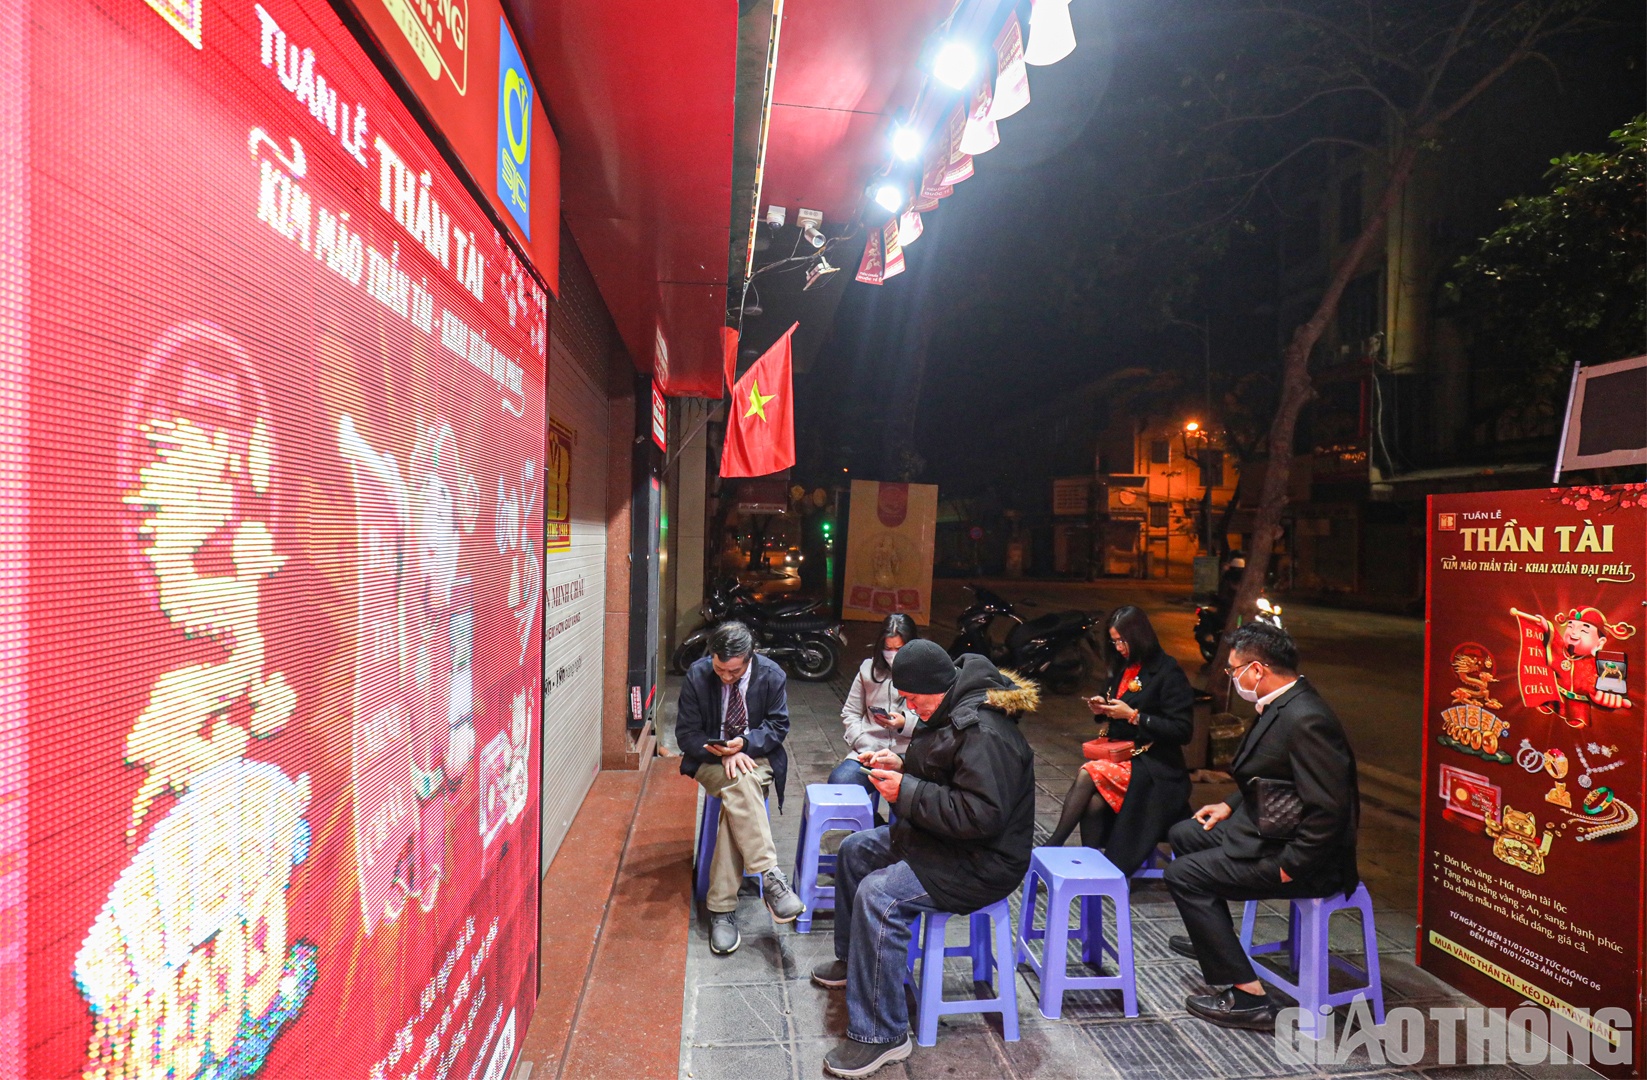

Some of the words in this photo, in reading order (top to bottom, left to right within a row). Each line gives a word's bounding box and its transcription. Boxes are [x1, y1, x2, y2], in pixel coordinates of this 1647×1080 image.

[502, 148, 527, 213] SJC
[454, 225, 485, 303] TÀI
[1460, 519, 1545, 552] THẦN
[1554, 519, 1614, 552] TÀI
[1442, 557, 1458, 570] KIM
[1479, 557, 1501, 572] THẦN
[1503, 560, 1517, 572] TÀI
[1525, 563, 1548, 573] KHAI
[1550, 561, 1578, 574] XUÂN
[1580, 564, 1599, 577] ĐẠI
[1600, 562, 1633, 578] PHÁT
[1523, 665, 1548, 676] MINH
[1525, 682, 1553, 695] CHÂU
[1443, 866, 1461, 883] Tặng
[1462, 878, 1477, 888] quà
[1478, 882, 1497, 900] bằng
[1499, 893, 1519, 909] vàng
[1526, 904, 1542, 918] An,
[1544, 913, 1568, 930] sang,
[1570, 922, 1595, 941] hạnh
[1597, 937, 1624, 954] phúc
[1444, 854, 1459, 867] Đón
[1461, 861, 1472, 873] lộc
[1474, 869, 1492, 884] vàng
[1500, 878, 1515, 892] Hút
[1517, 887, 1537, 902] ngàn
[1540, 895, 1551, 907] tài
[1553, 900, 1568, 914] lộc
[1443, 879, 1454, 891] Đa
[1455, 886, 1474, 902] dạng
[1511, 910, 1529, 926] kiểu
[1530, 920, 1555, 939] dáng,
[1557, 934, 1572, 946] giá
[1574, 941, 1589, 954] cả.
[1434, 936, 1452, 952] MUA
[1453, 945, 1476, 965] VÀNG
[1501, 972, 1516, 987] TÀI
[1522, 983, 1541, 1000] KÉO
[1542, 995, 1560, 1009] DÀI
[1449, 910, 1459, 920] TỪ
[1459, 916, 1478, 929] NGÀY
[1477, 925, 1487, 933] 27
[1487, 929, 1502, 942] ĐẾN
[1502, 937, 1544, 963] 31/01/2023
[1545, 957, 1562, 972] TỨC
[1589, 981, 1601, 991] 06
[1469, 929, 1484, 942] ĐẾN
[1484, 937, 1499, 949] HẾT
[1499, 945, 1539, 970] 10/01/2023
[1554, 973, 1573, 988] LỊCH
